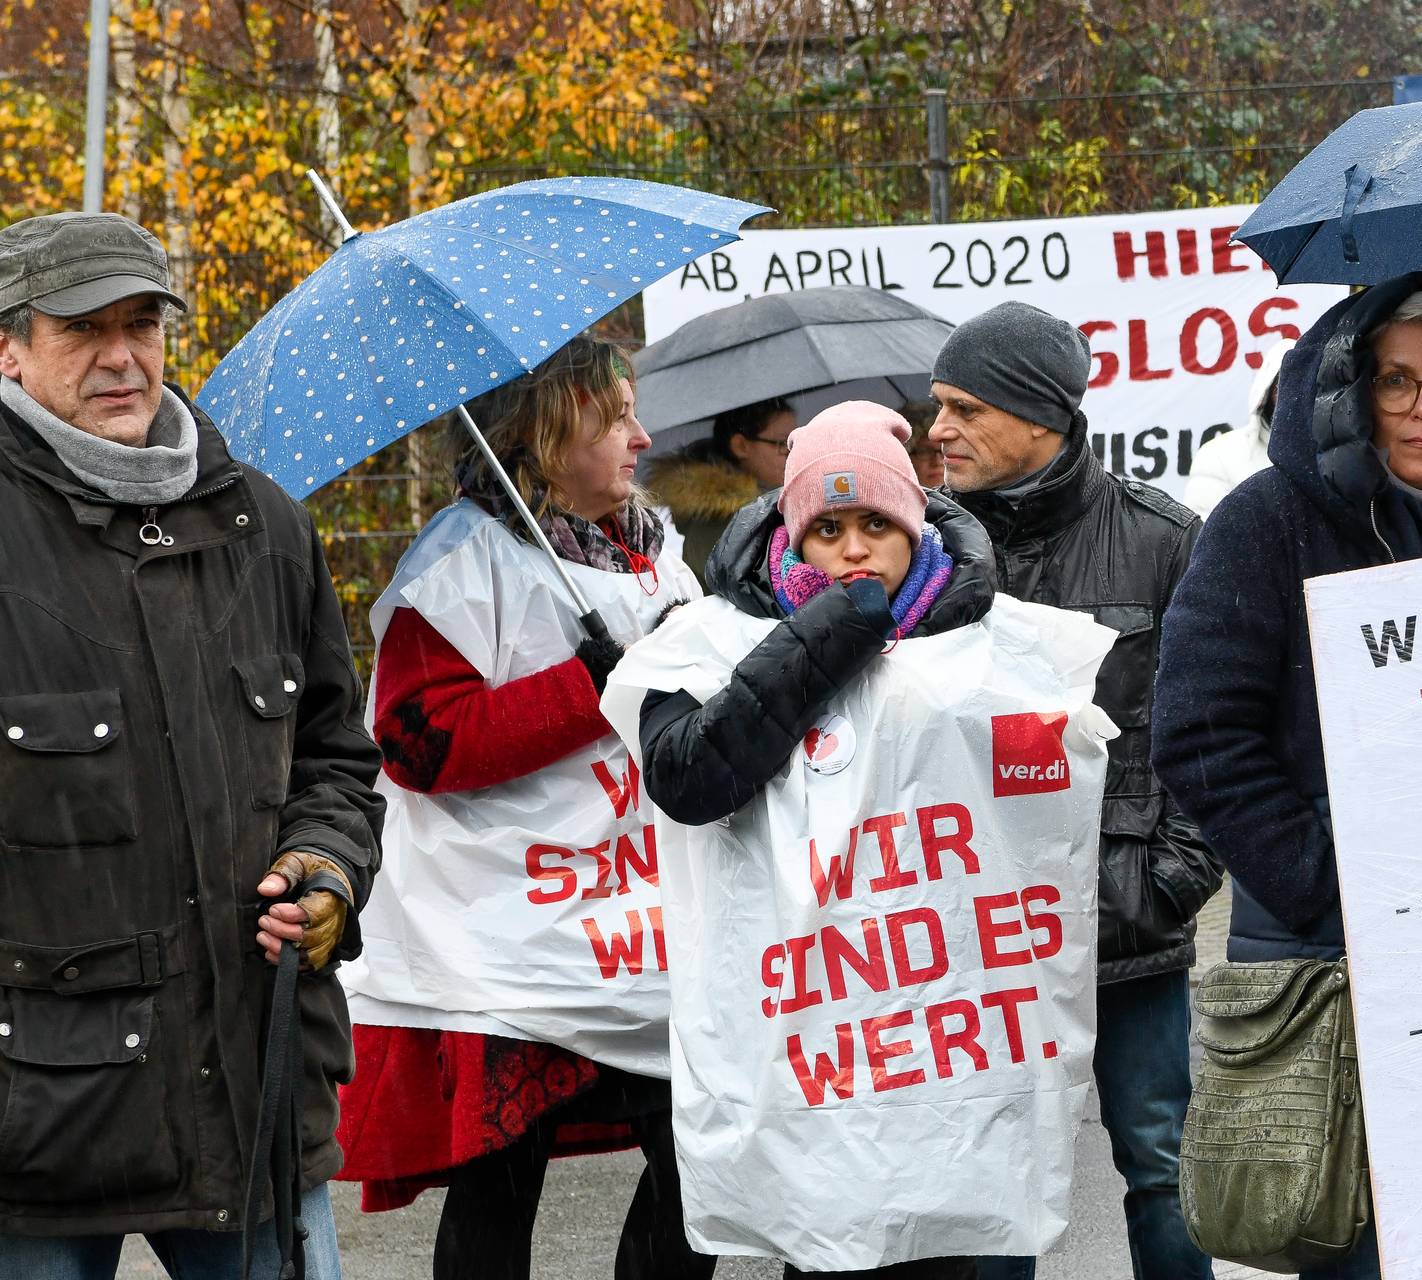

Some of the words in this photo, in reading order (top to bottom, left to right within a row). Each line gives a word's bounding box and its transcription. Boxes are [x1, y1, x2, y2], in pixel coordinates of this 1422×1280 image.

[680, 252, 738, 292] AB
[764, 246, 904, 292] APRIL
[929, 231, 1070, 289] 2020
[1113, 225, 1271, 283] HIE
[998, 759, 1065, 781] ver.di
[809, 802, 981, 909] WIR
[761, 906, 949, 1019] SIND
[973, 884, 1063, 970] ES
[786, 986, 1058, 1107] WERT.
